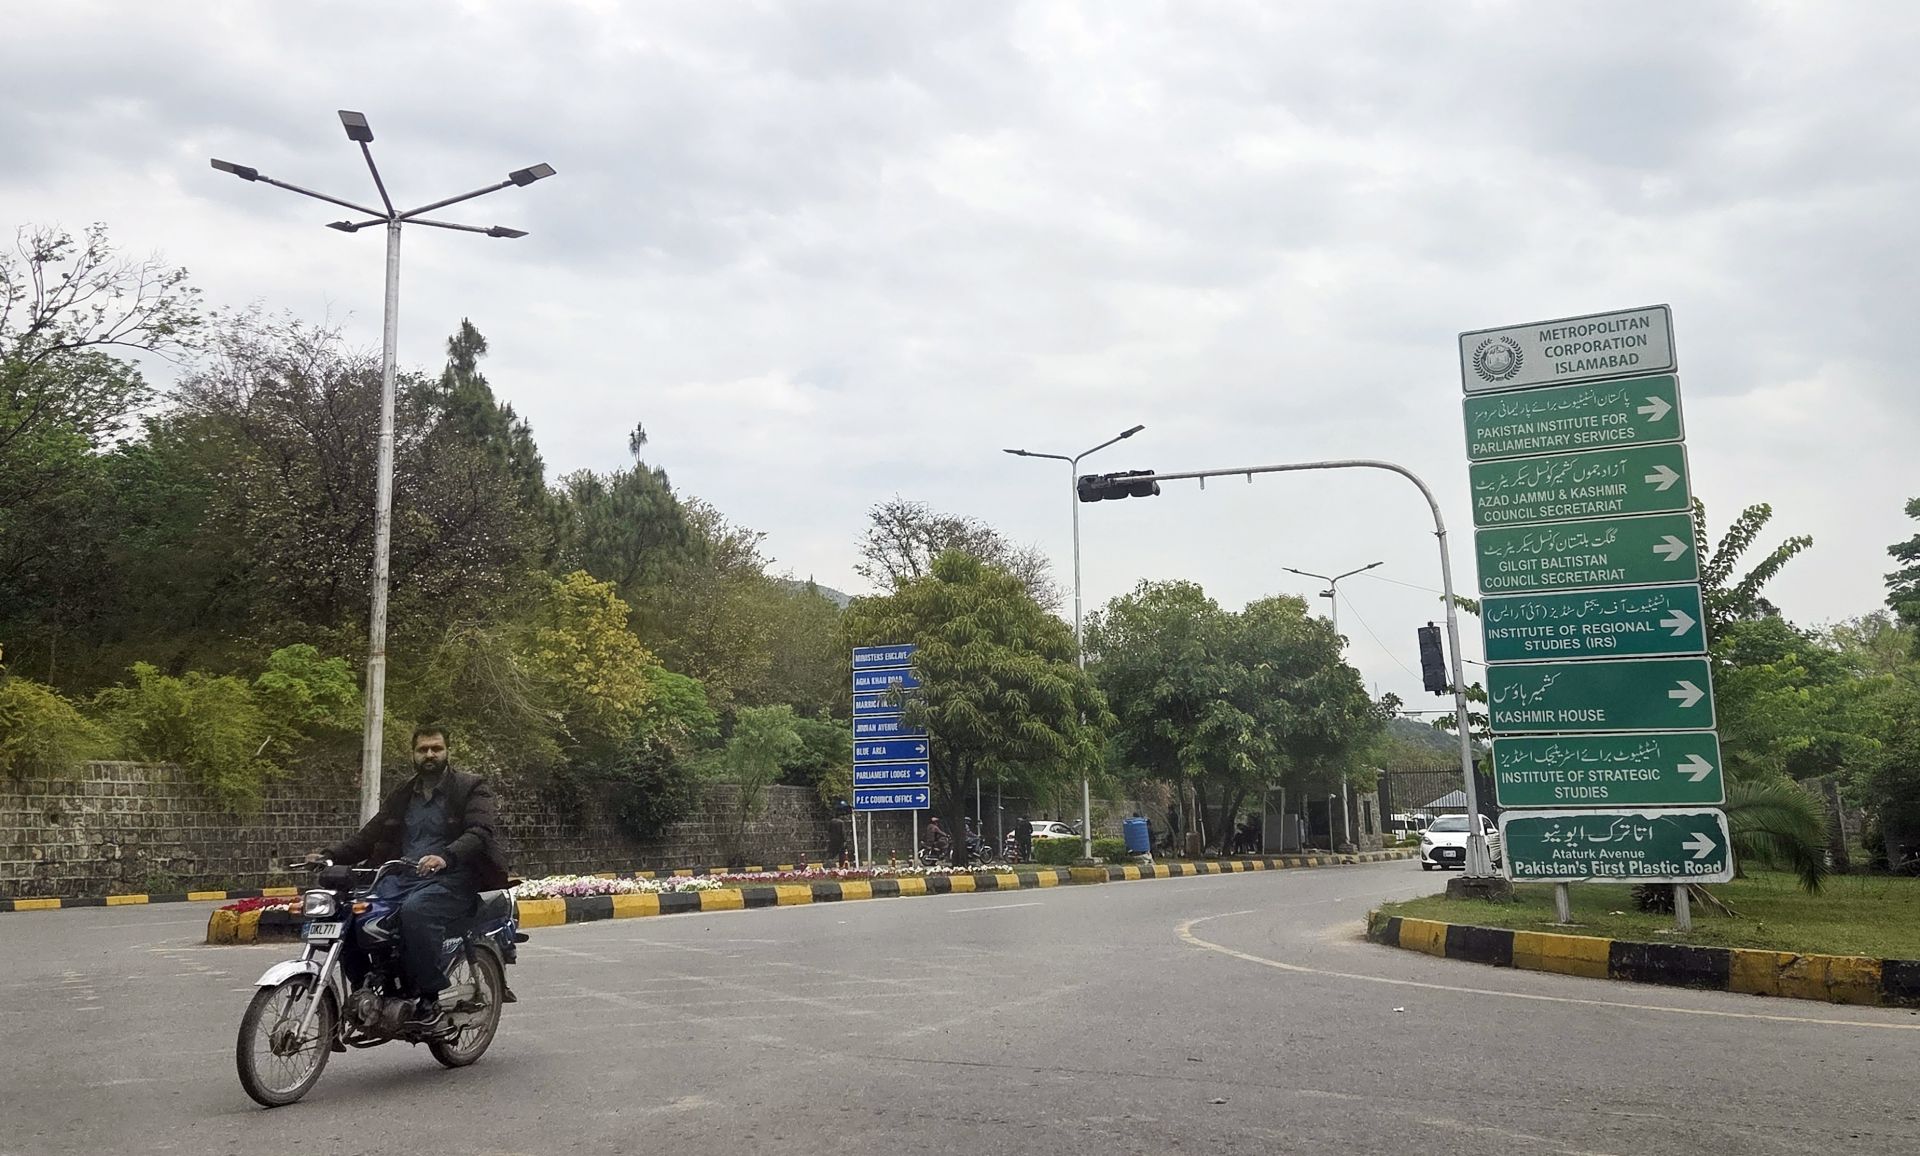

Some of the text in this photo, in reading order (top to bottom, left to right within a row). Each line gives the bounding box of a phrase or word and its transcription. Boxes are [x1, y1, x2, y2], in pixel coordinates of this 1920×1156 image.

[1540, 317, 1650, 343] METROPOLITAN
[1545, 334, 1647, 358] CORPORATION
[1556, 353, 1639, 374] ISLAMABAD
[1532, 397, 1557, 413] برائے
[1597, 388, 1630, 407] پاکستان
[1477, 412, 1627, 439] PAKISTAN INSTITUTE FOR
[1473, 427, 1635, 454] PARLIAMENTARY SERVICES
[1551, 459, 1579, 487] کشمیر
[1573, 464, 1601, 482] جموں
[1602, 459, 1628, 478] آزاد
[1478, 484, 1628, 508] AZAD JAMMU & KASHMIR
[1484, 500, 1623, 522] COUNCIL SECRETARIAT
[1591, 528, 1618, 547] گلگت
[1499, 554, 1608, 573] GILGIT BALTISTAN
[1485, 569, 1625, 588] COUNCIL SECRETARIAT
[1604, 600, 1625, 614] آف
[1488, 621, 1655, 639] INSTITUTE OF REGIONAL
[1524, 636, 1617, 651] STUDIES (IRS)
[885, 652, 907, 661] ENCLAVE
[1493, 672, 1561, 706] کشمیر ہاؤس
[1495, 709, 1605, 723] KASHMIR HOUSE
[878, 722, 898, 731] AVENUE
[856, 747, 886, 756] BLUE AREA
[1581, 748, 1612, 763] برائے
[856, 770, 910, 780] PARLIAMENT LODGES
[1502, 769, 1660, 783] INSTITUTE OF STRATEGIC
[870, 796, 893, 804] COUNCIL
[895, 795, 912, 803] OFFICE
[1554, 786, 1608, 799] STUDIES
[1552, 849, 1645, 859] Ataturk Avenue
[1592, 861, 1625, 875] First
[1630, 861, 1680, 875] Plastic
[1685, 861, 1722, 874] Road
